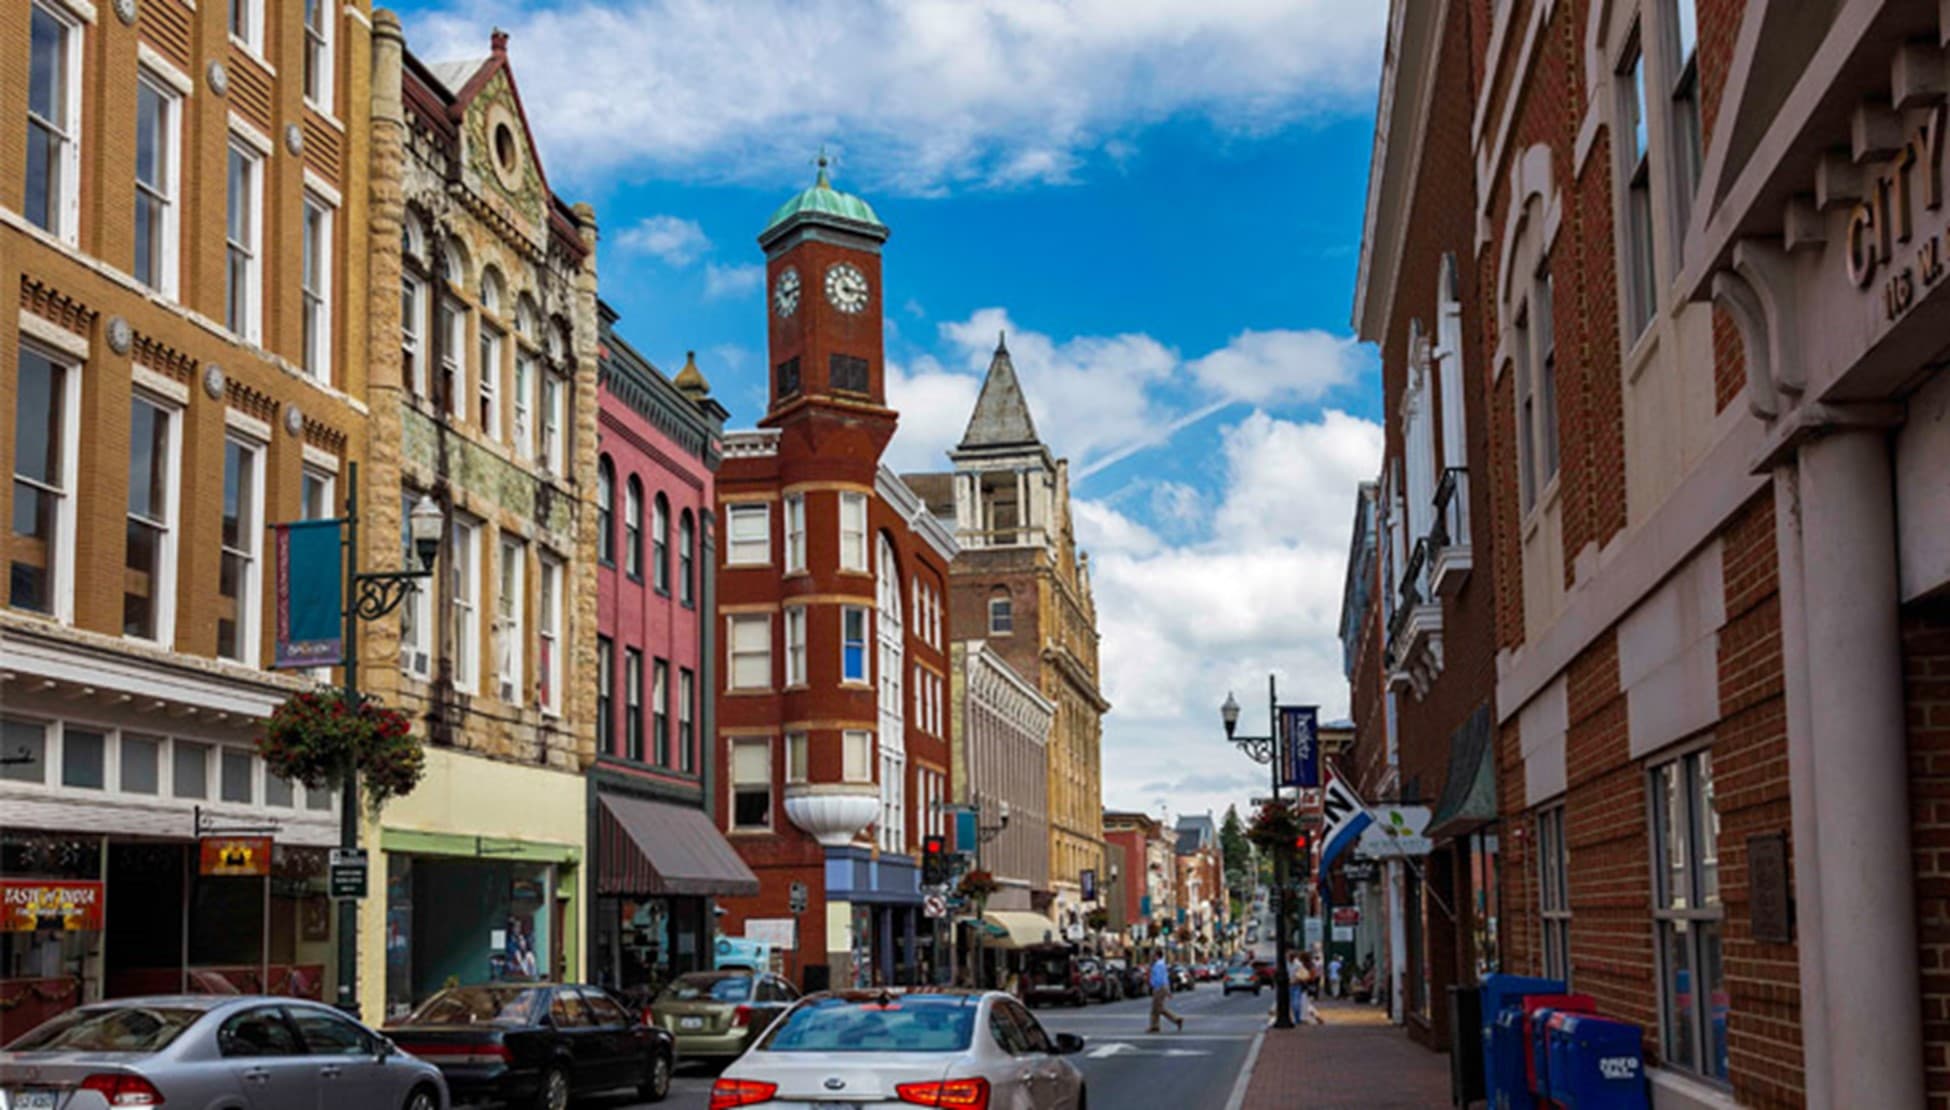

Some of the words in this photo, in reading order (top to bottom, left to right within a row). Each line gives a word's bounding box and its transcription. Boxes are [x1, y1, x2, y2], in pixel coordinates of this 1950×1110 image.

[1847, 102, 1947, 291] CITY
[4, 887, 40, 904] TASTE
[58, 888, 95, 904] INDIA
